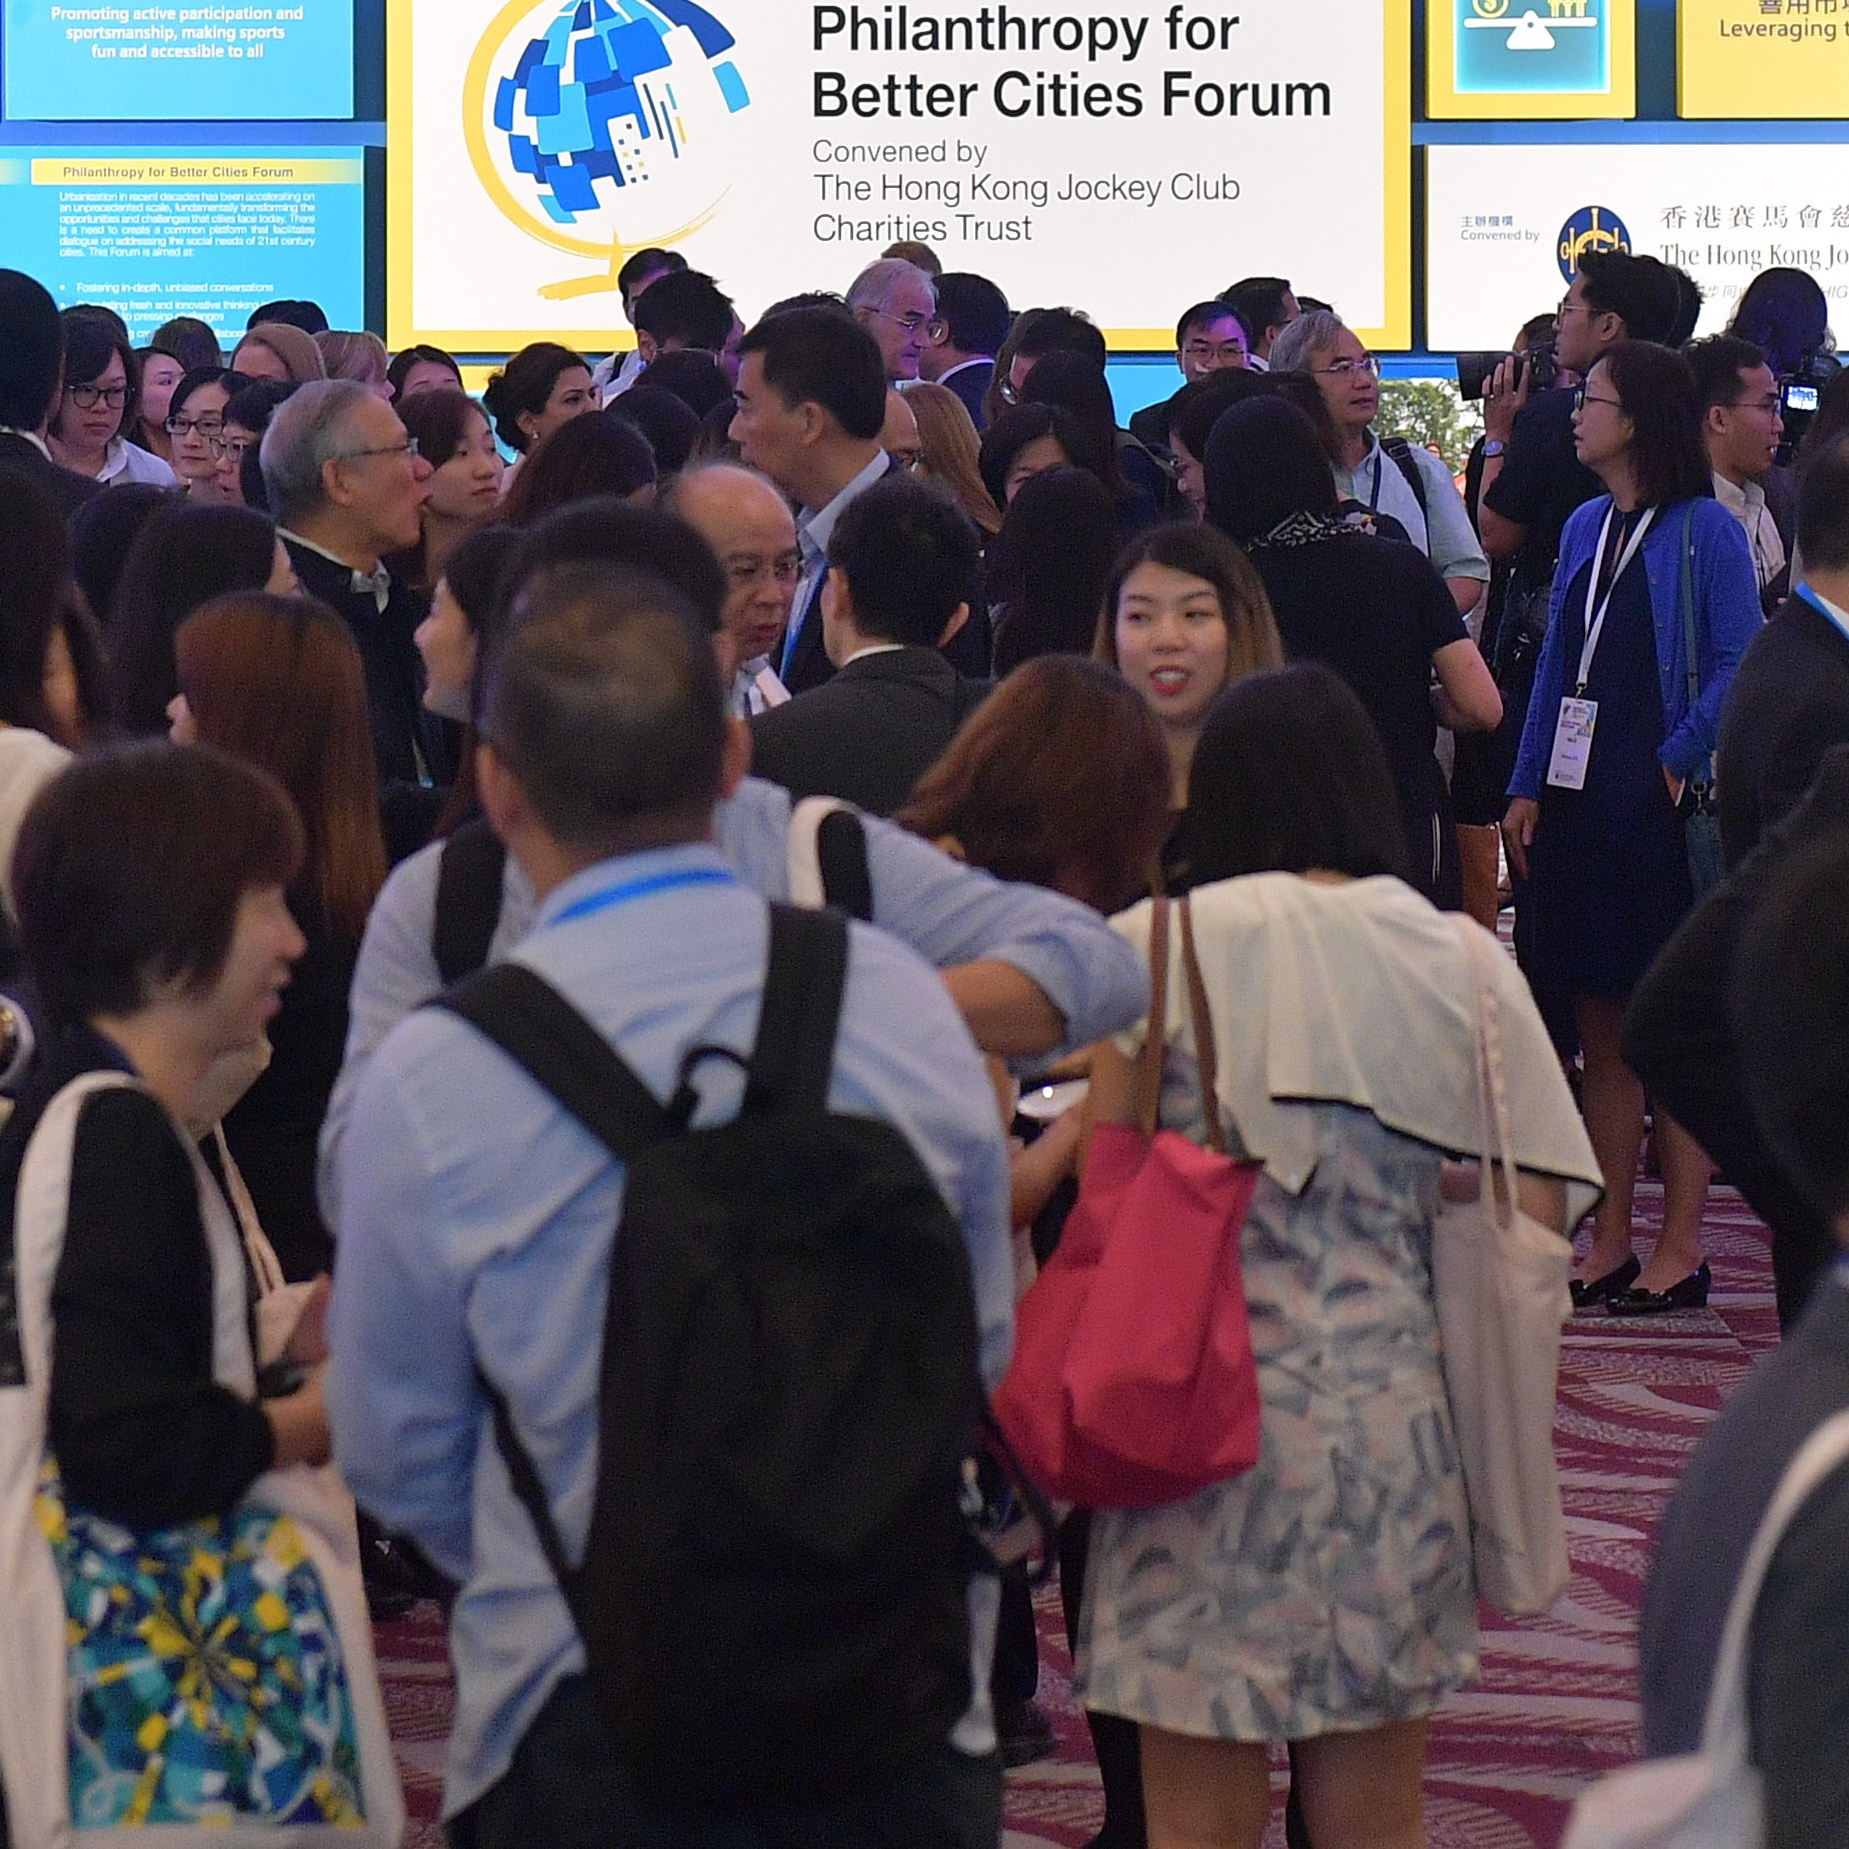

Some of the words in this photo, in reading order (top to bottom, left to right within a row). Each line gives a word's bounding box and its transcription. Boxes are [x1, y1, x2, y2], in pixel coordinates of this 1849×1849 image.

[51, 7, 129, 24] Promoting
[133, 7, 176, 20] active
[180, 7, 272, 24] participation
[276, 7, 303, 20] and
[66, 25, 178, 42] sportsmanship,
[182, 25, 236, 42] making
[240, 25, 285, 42] sports
[813, 5, 1149, 62] Philanthropy
[1164, 5, 1240, 51] for
[1720, 19, 1837, 42] Leveraging
[91, 44, 116, 58] fun
[120, 44, 147, 58] and
[151, 44, 224, 58] accessible
[228, 44, 243, 58] to
[247, 44, 263, 58] all
[813, 71, 978, 117] Better
[993, 71, 1143, 117] Cities
[1163, 71, 1331, 117] Forum
[813, 140, 946, 163] Convened
[957, 140, 987, 167] by
[63, 167, 144, 180] Philanthropy
[148, 167, 166, 178] for
[170, 167, 208, 178] Better
[212, 167, 248, 178] Cities
[252, 167, 294, 178] Forum
[814, 174, 871, 201] The
[882, 174, 961, 208] Hong
[971, 174, 1048, 208] Kong
[1058, 173, 1162, 208] Jockey
[1171, 173, 1240, 201] Club
[813, 214, 947, 242] Charities
[956, 214, 1033, 242] Trust
[1461, 229, 1522, 241] Convened
[1525, 229, 1540, 244] by
[1660, 243, 1700, 265] The
[1707, 243, 1762, 270] Hong
[1770, 244, 1822, 270] Kong
